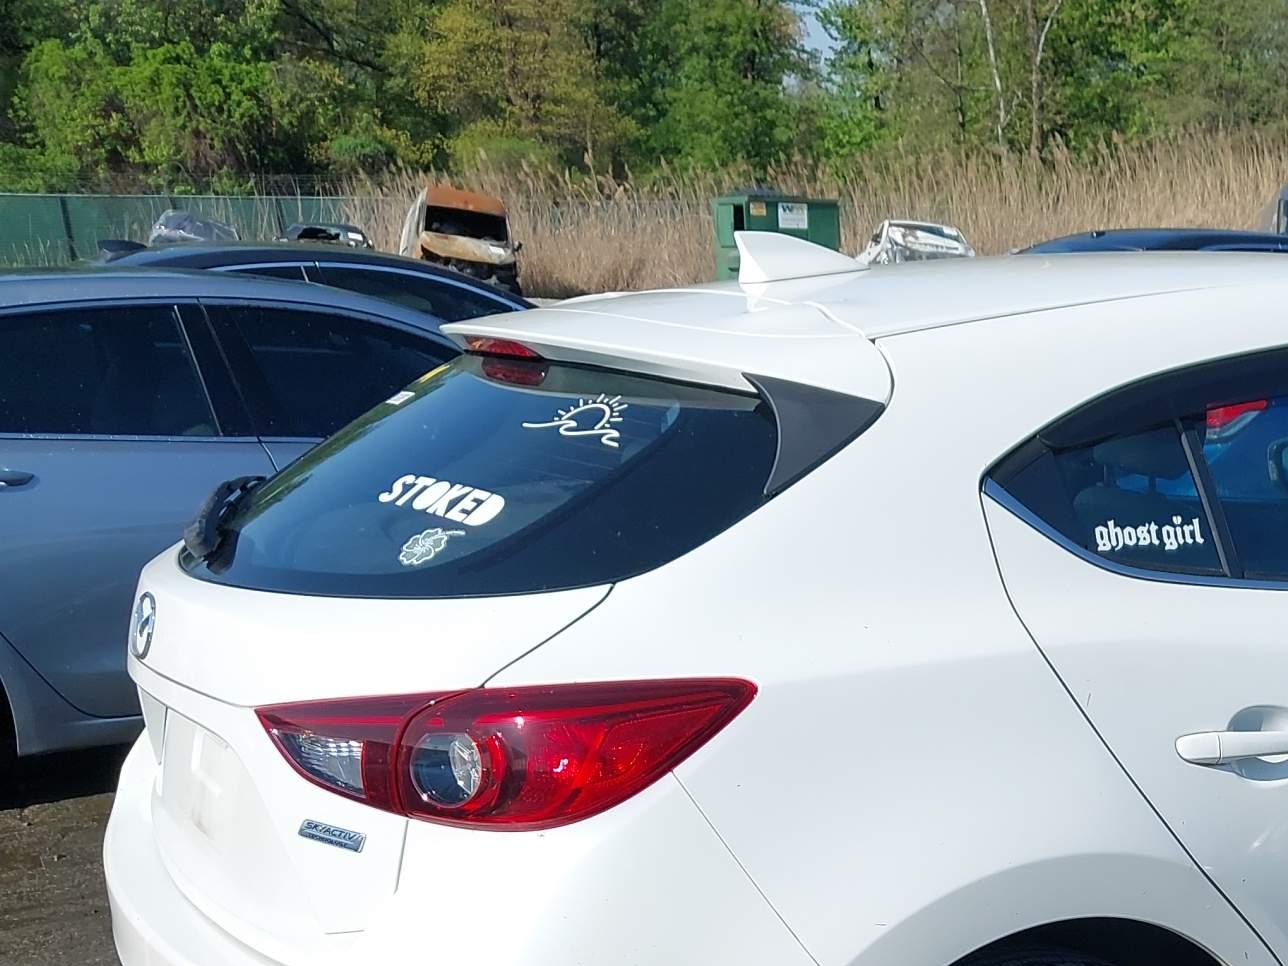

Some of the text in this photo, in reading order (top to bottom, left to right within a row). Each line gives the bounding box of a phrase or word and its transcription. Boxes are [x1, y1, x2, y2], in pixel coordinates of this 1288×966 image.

[378, 474, 505, 526] STOKED
[1094, 515, 1204, 551] ghost girl
